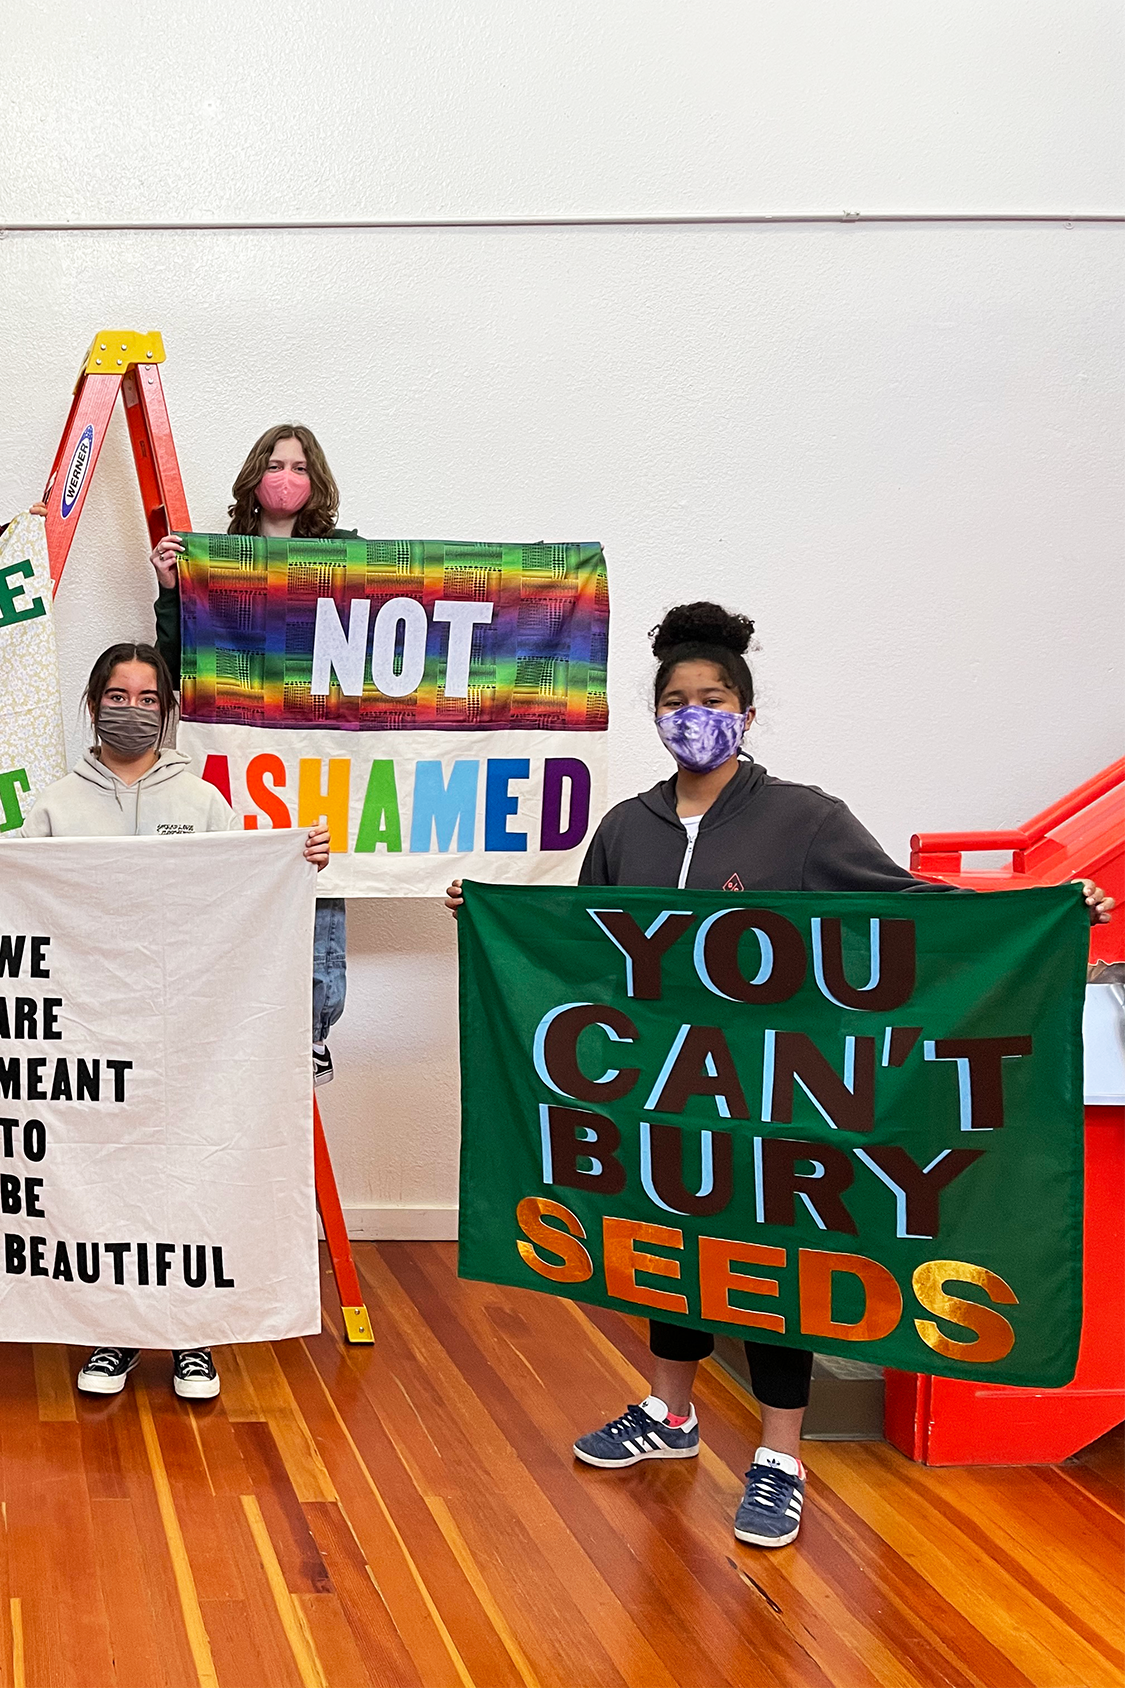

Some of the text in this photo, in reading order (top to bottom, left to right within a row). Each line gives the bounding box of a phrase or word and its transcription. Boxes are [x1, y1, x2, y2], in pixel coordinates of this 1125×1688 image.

[66, 442, 89, 499] WERNER
[310, 597, 494, 698] NOT
[586, 907, 916, 1012] YOU
[533, 1002, 1033, 1132] CAN'T
[0, 1173, 45, 1218] BE
[538, 1103, 987, 1240] BURY
[4, 1233, 235, 1289] BEAUTIFUL
[515, 1196, 1020, 1363] SEEDS
